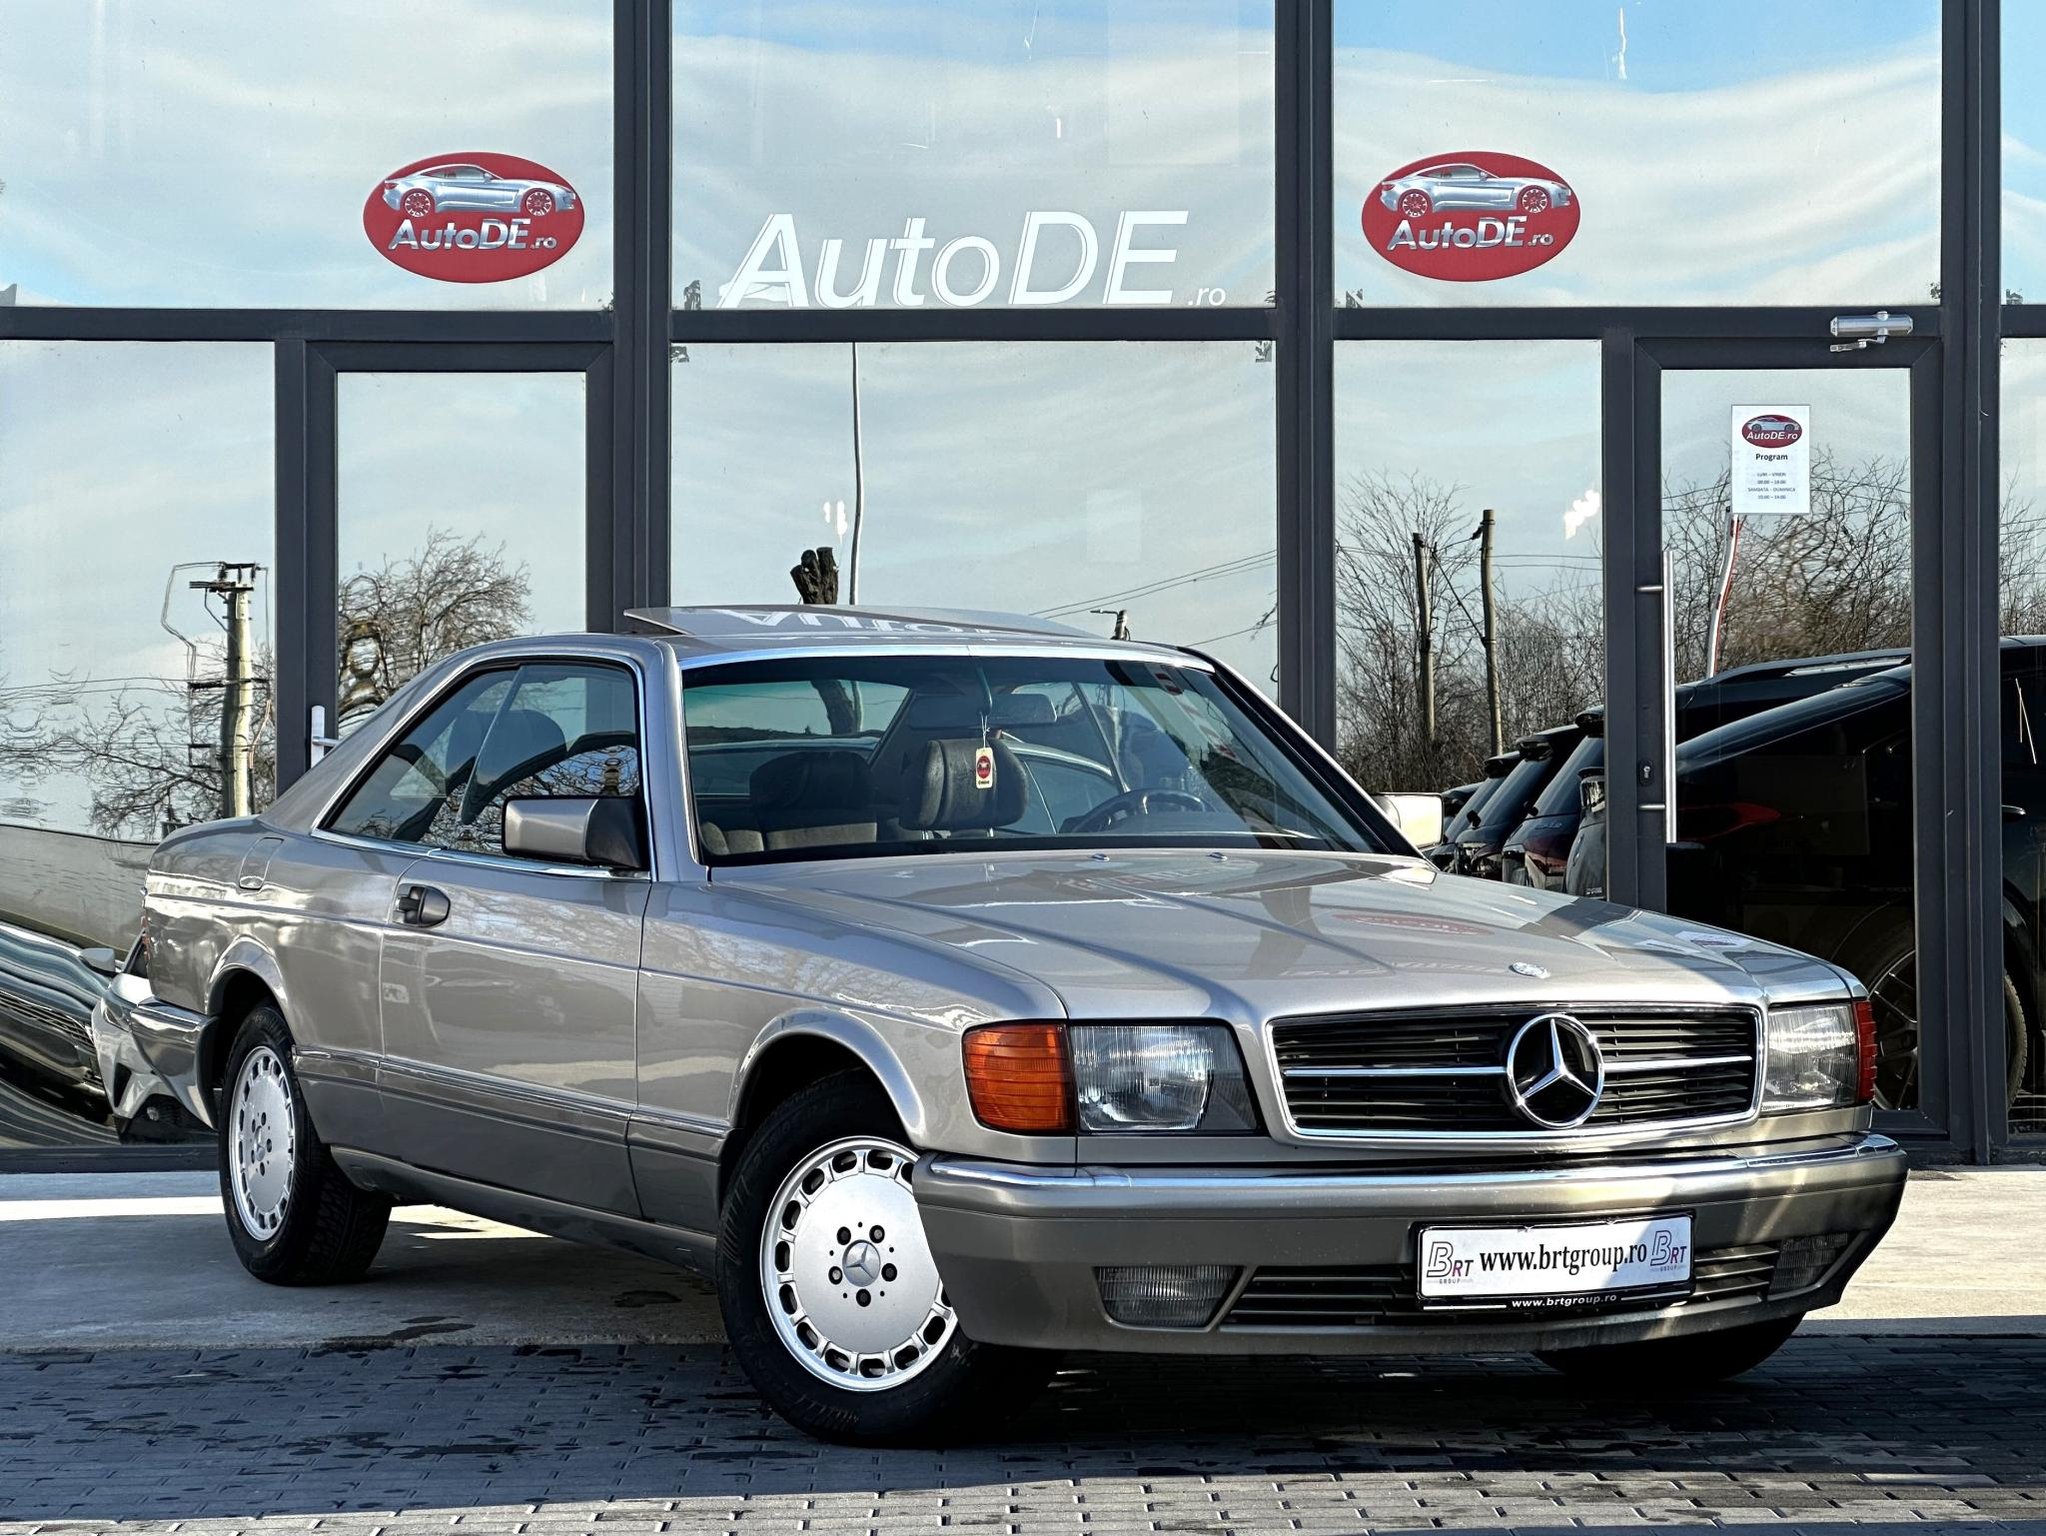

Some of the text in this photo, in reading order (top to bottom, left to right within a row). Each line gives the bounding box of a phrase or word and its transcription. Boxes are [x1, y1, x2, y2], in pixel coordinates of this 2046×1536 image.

[388, 217, 558, 251] AutoDE.ro
[1387, 215, 1554, 251] AutoDE.ro
[1746, 431, 1798, 440] AutoDE.ro
[1755, 453, 1788, 461] Program
[1426, 1241, 1474, 1278] BRT
[1480, 1243, 1647, 1275] www.brtgroup.ro
[1650, 1229, 1688, 1267] BRT
[1511, 1292, 1618, 1309] www.brtgroup.ro
